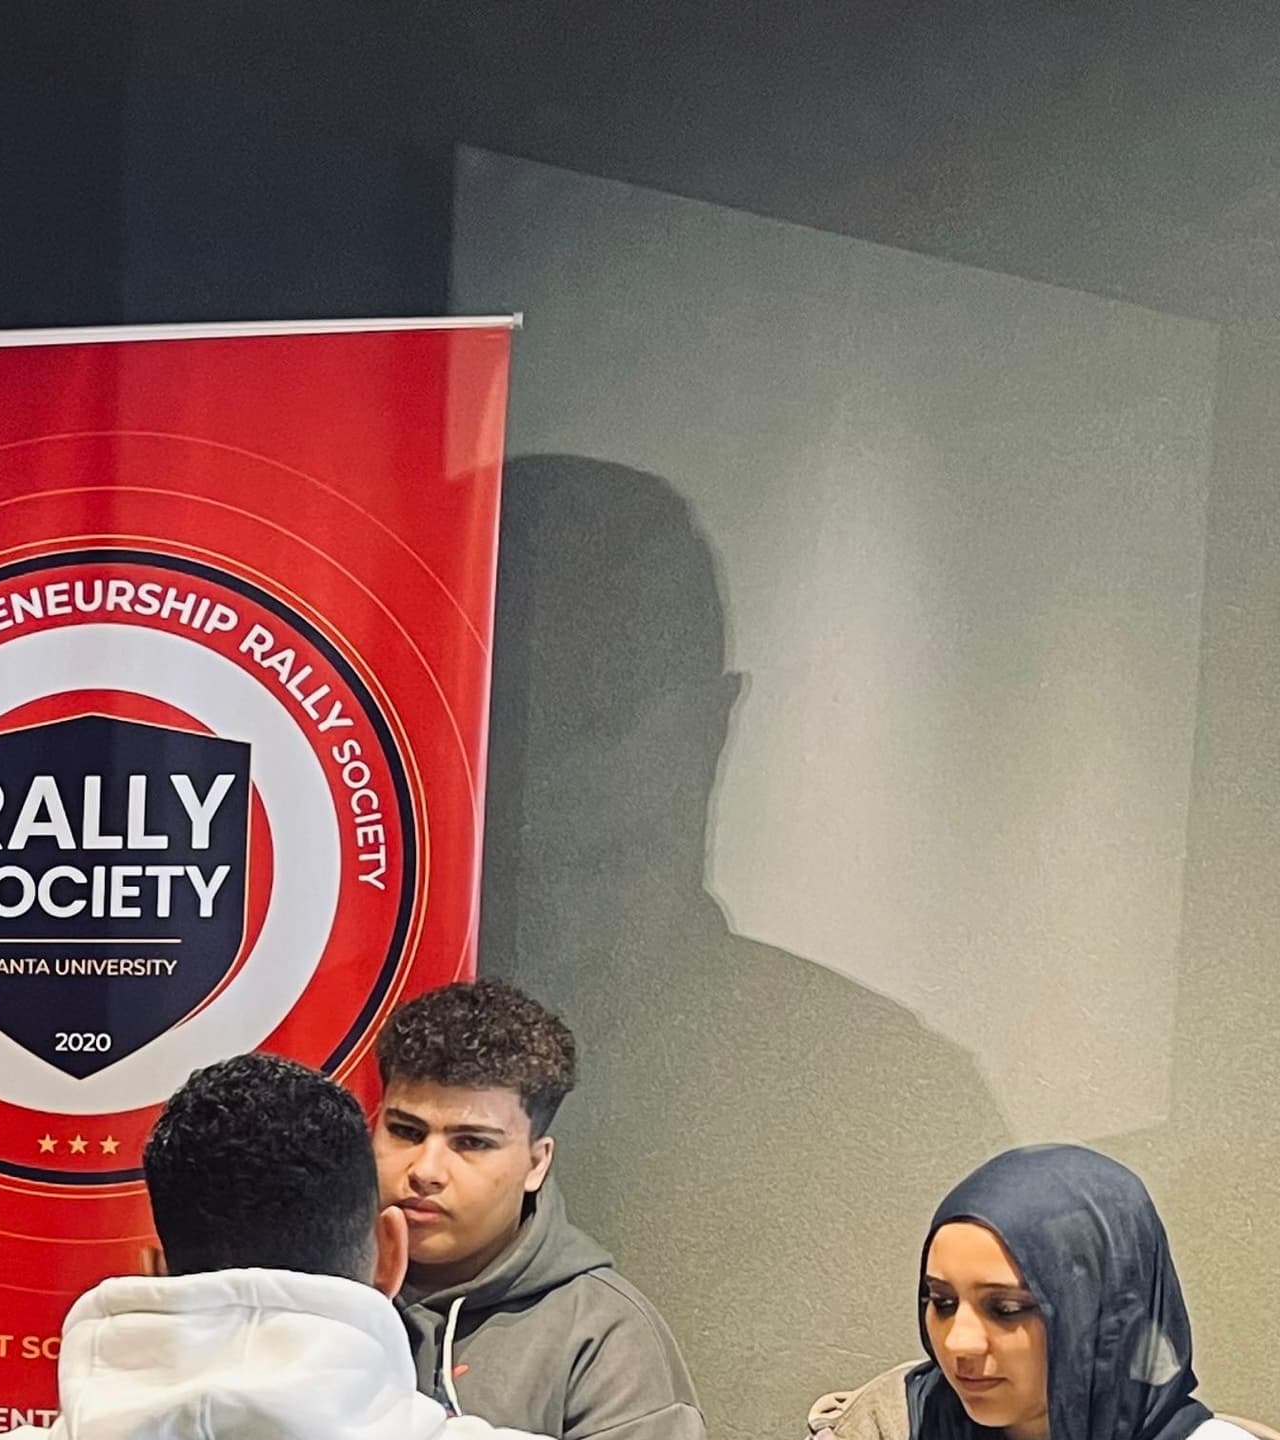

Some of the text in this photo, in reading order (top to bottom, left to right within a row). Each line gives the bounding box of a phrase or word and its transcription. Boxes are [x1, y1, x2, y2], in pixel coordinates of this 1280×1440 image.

[239, 624, 354, 732] RALLY
[332, 739, 387, 890] SOCIETY
[55, 957, 178, 976] UNIVERSITY
[55, 1032, 111, 1052] 2020
